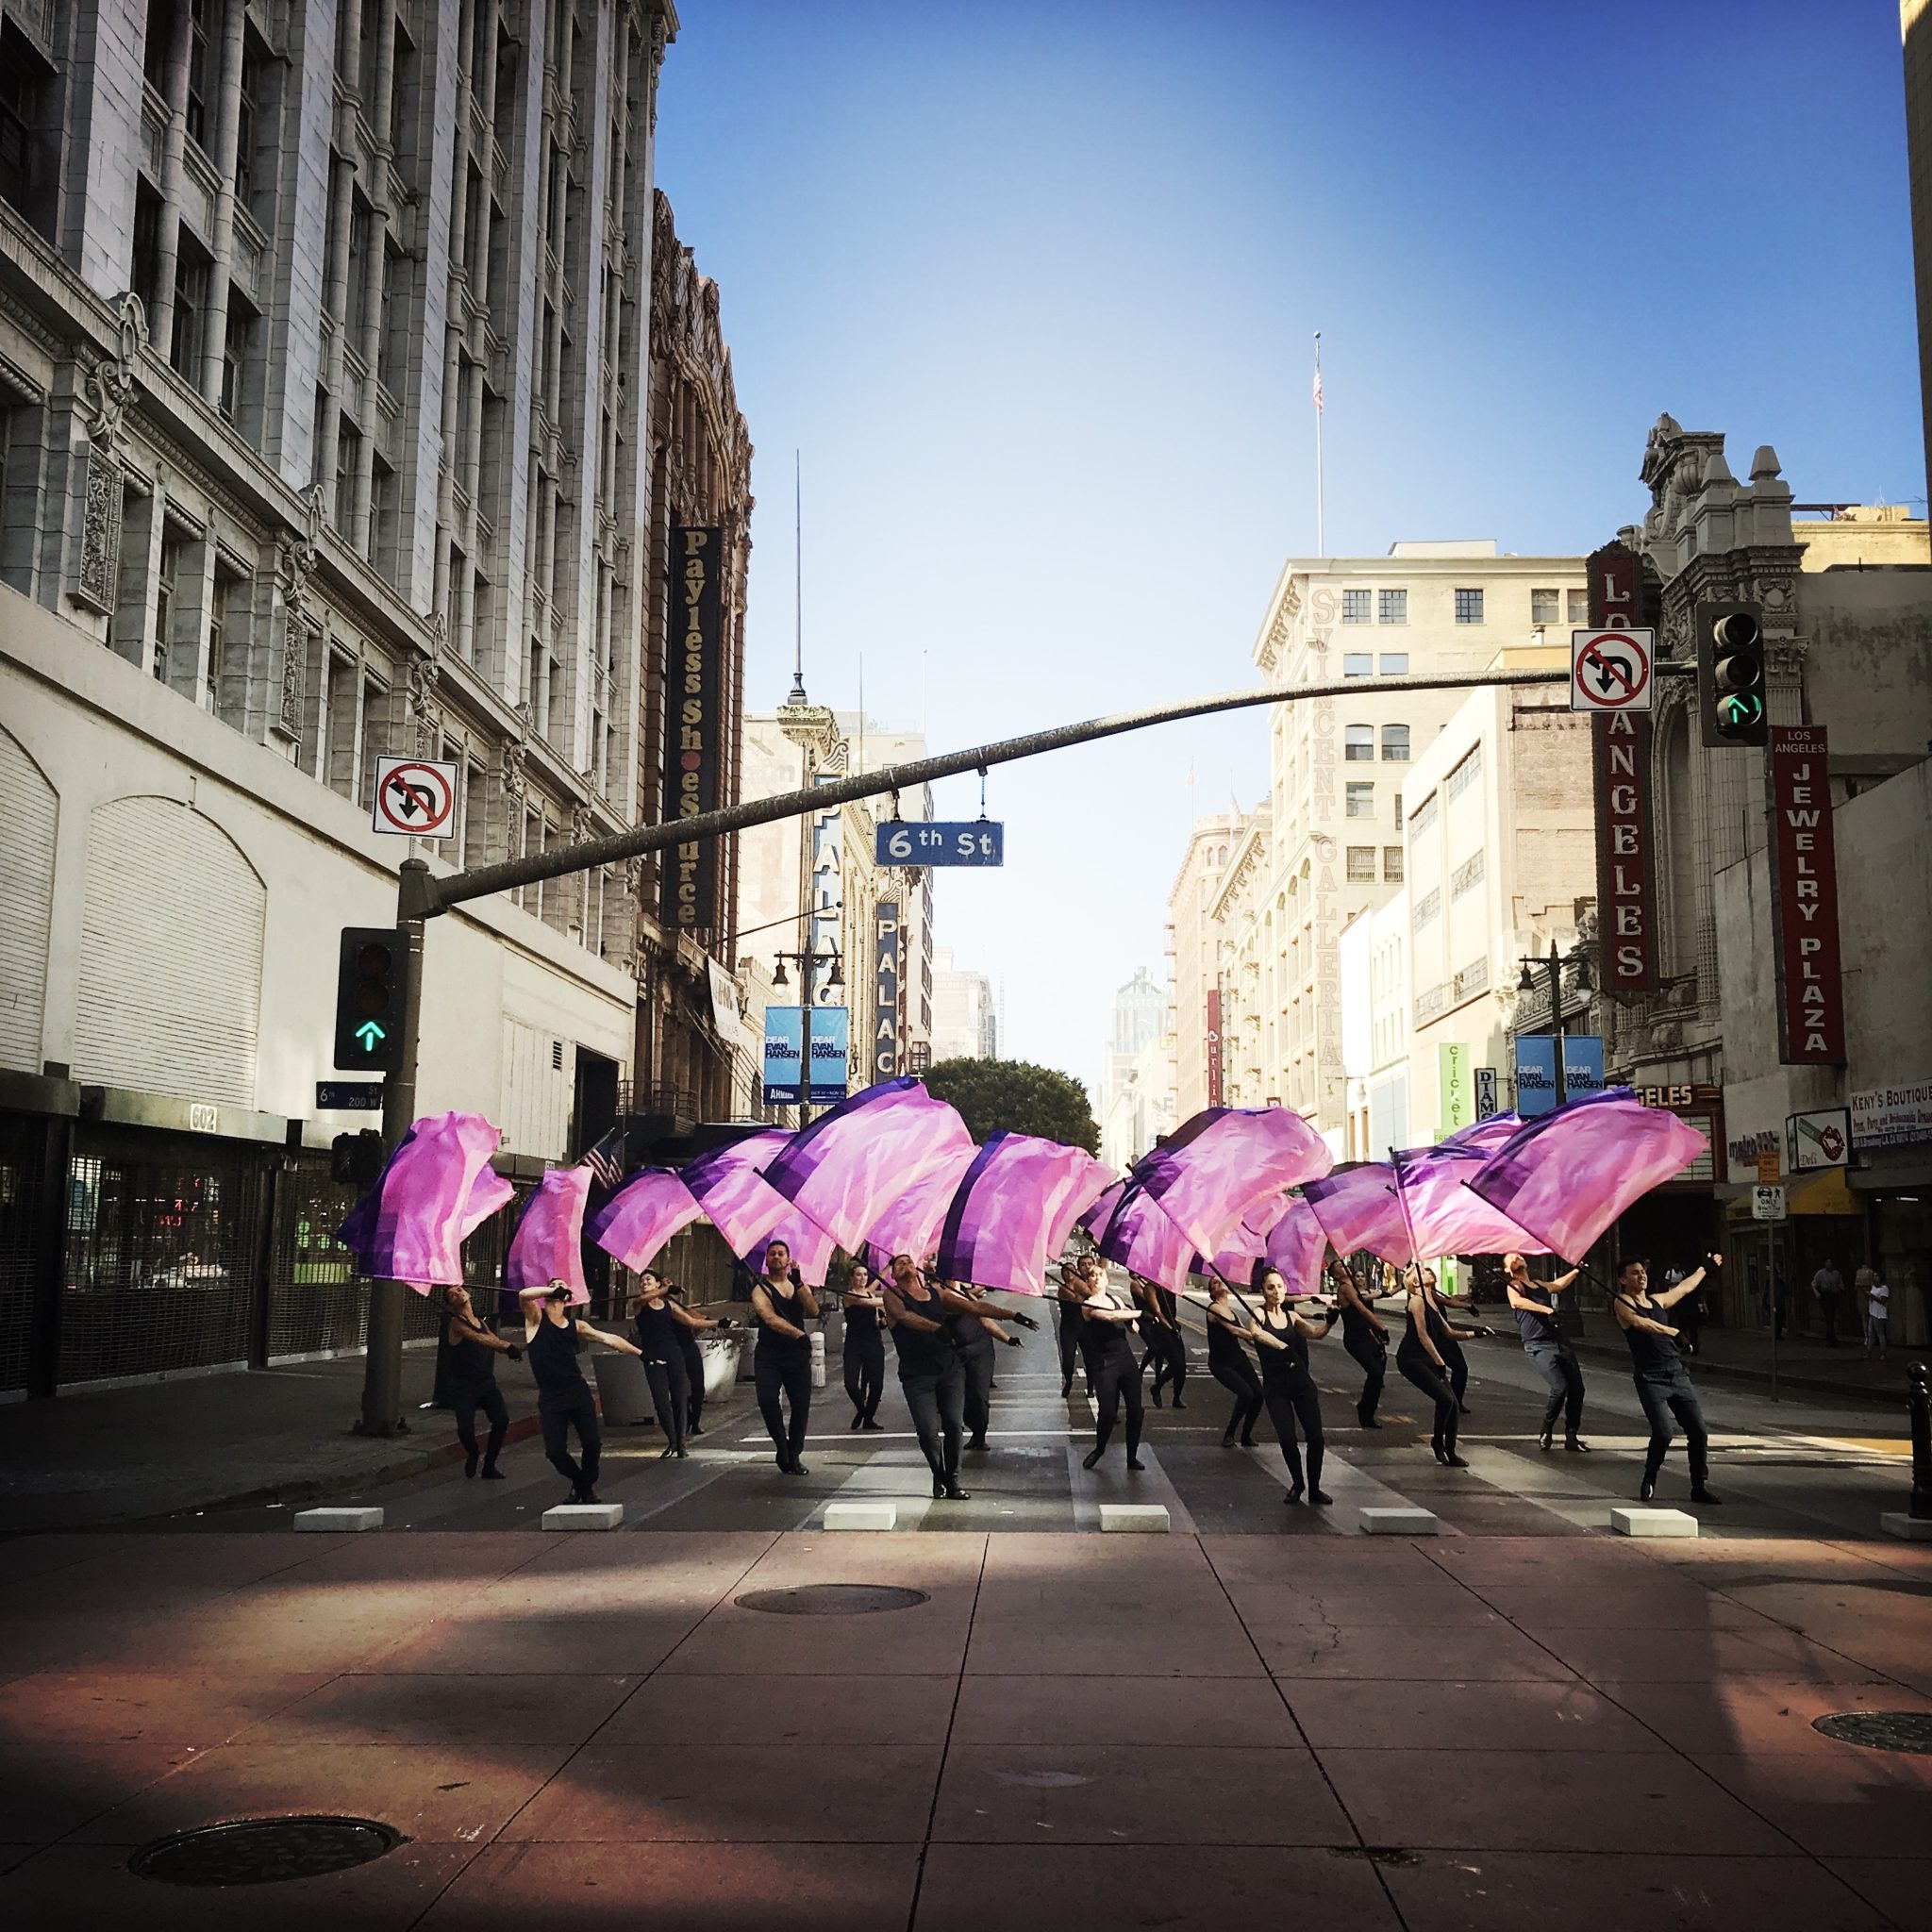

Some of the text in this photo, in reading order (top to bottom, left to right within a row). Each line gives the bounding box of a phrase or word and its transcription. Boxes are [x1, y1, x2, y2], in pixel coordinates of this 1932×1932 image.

[685, 531, 708, 693] Payless
[1787, 731, 1811, 741] LOS
[1774, 743, 1825, 754] ANGELES
[889, 829, 992, 858] 6th St
[1608, 711, 1644, 977] ANGELES
[1786, 763, 1828, 1052] JEWELRY PLAZA
[1315, 836, 1341, 1066] GALLERIA
[766, 1042, 788, 1051] EVAN
[812, 1042, 834, 1051] EVAN
[766, 1050, 800, 1058] HANSEN
[812, 1050, 846, 1058] HANSEN
[1519, 1080, 1555, 1089] HANSEN
[1567, 1080, 1603, 1089] HANSEN
[1853, 1091, 1884, 1111] KENY'S
[192, 1107, 215, 1130] 602
